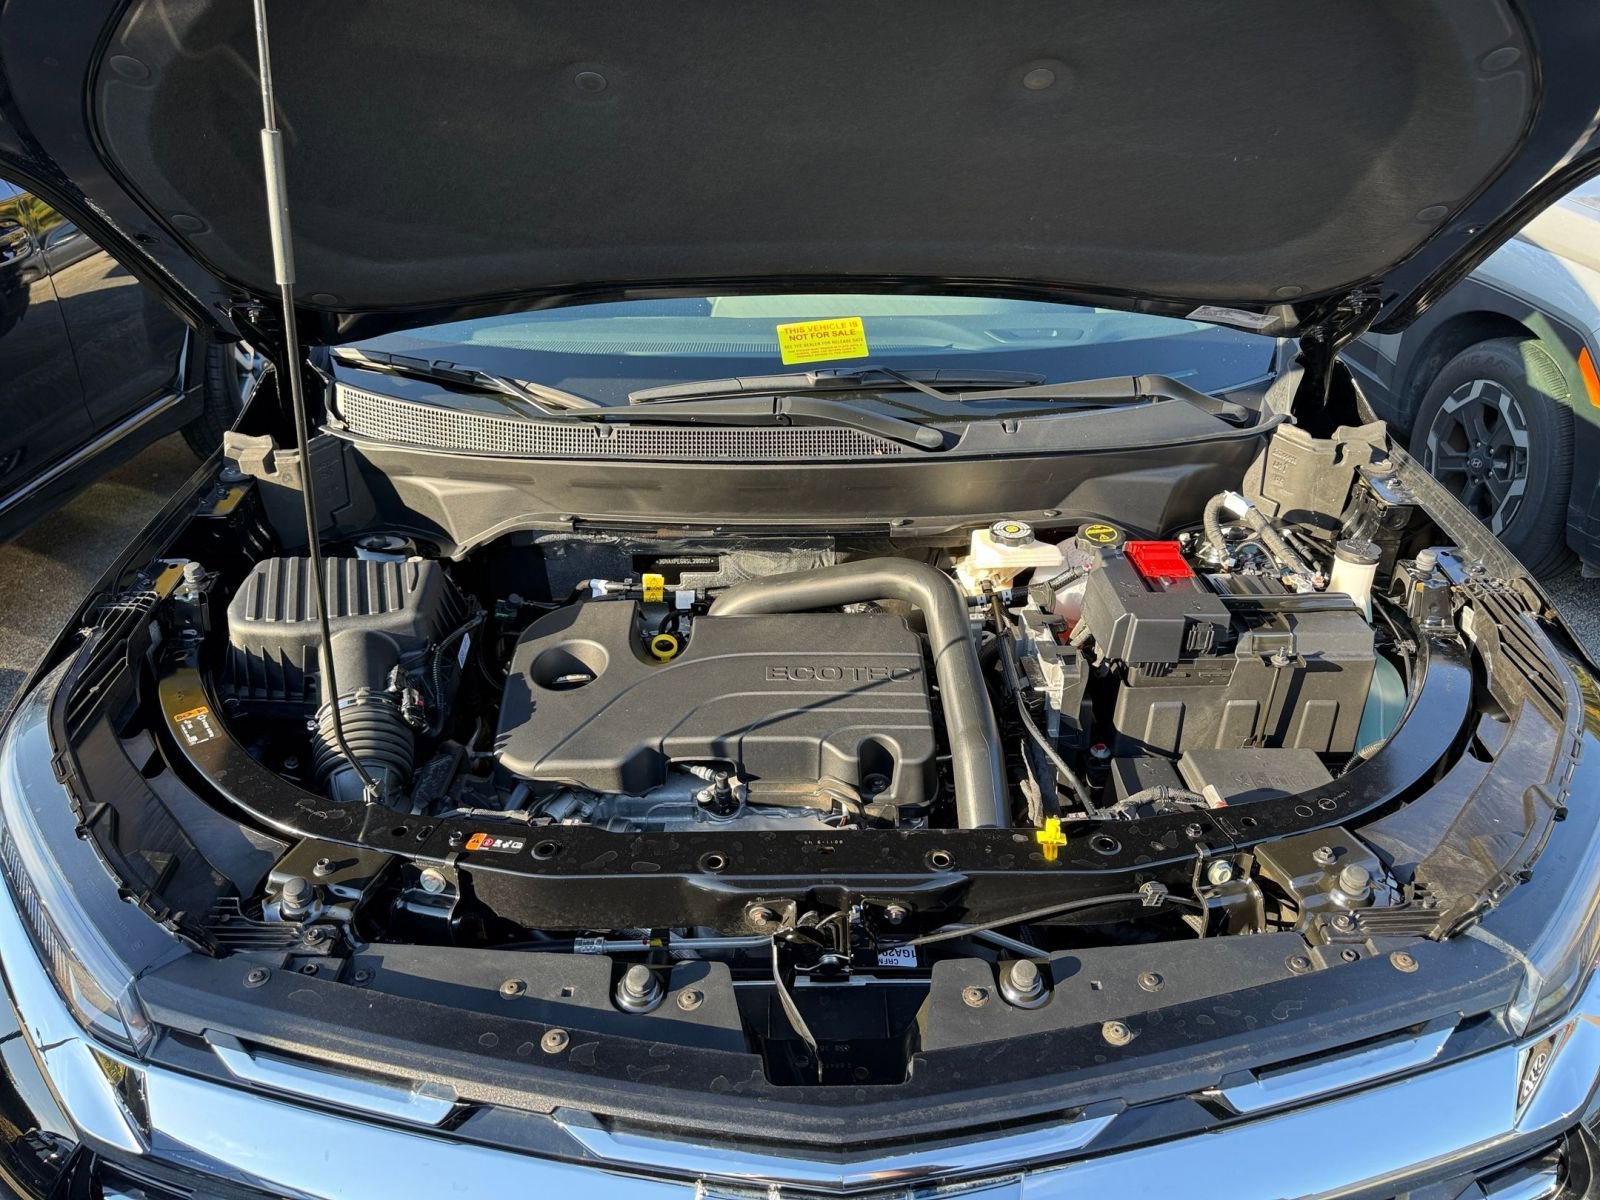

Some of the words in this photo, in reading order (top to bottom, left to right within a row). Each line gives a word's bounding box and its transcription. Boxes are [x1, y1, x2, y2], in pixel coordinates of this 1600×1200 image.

[784, 326, 805, 334] THIS
[807, 322, 846, 332] VEHICLE
[789, 333, 808, 341] NOT
[811, 331, 830, 339] FOR
[832, 329, 856, 337] SALE
[766, 666, 914, 682] ECOTEC
